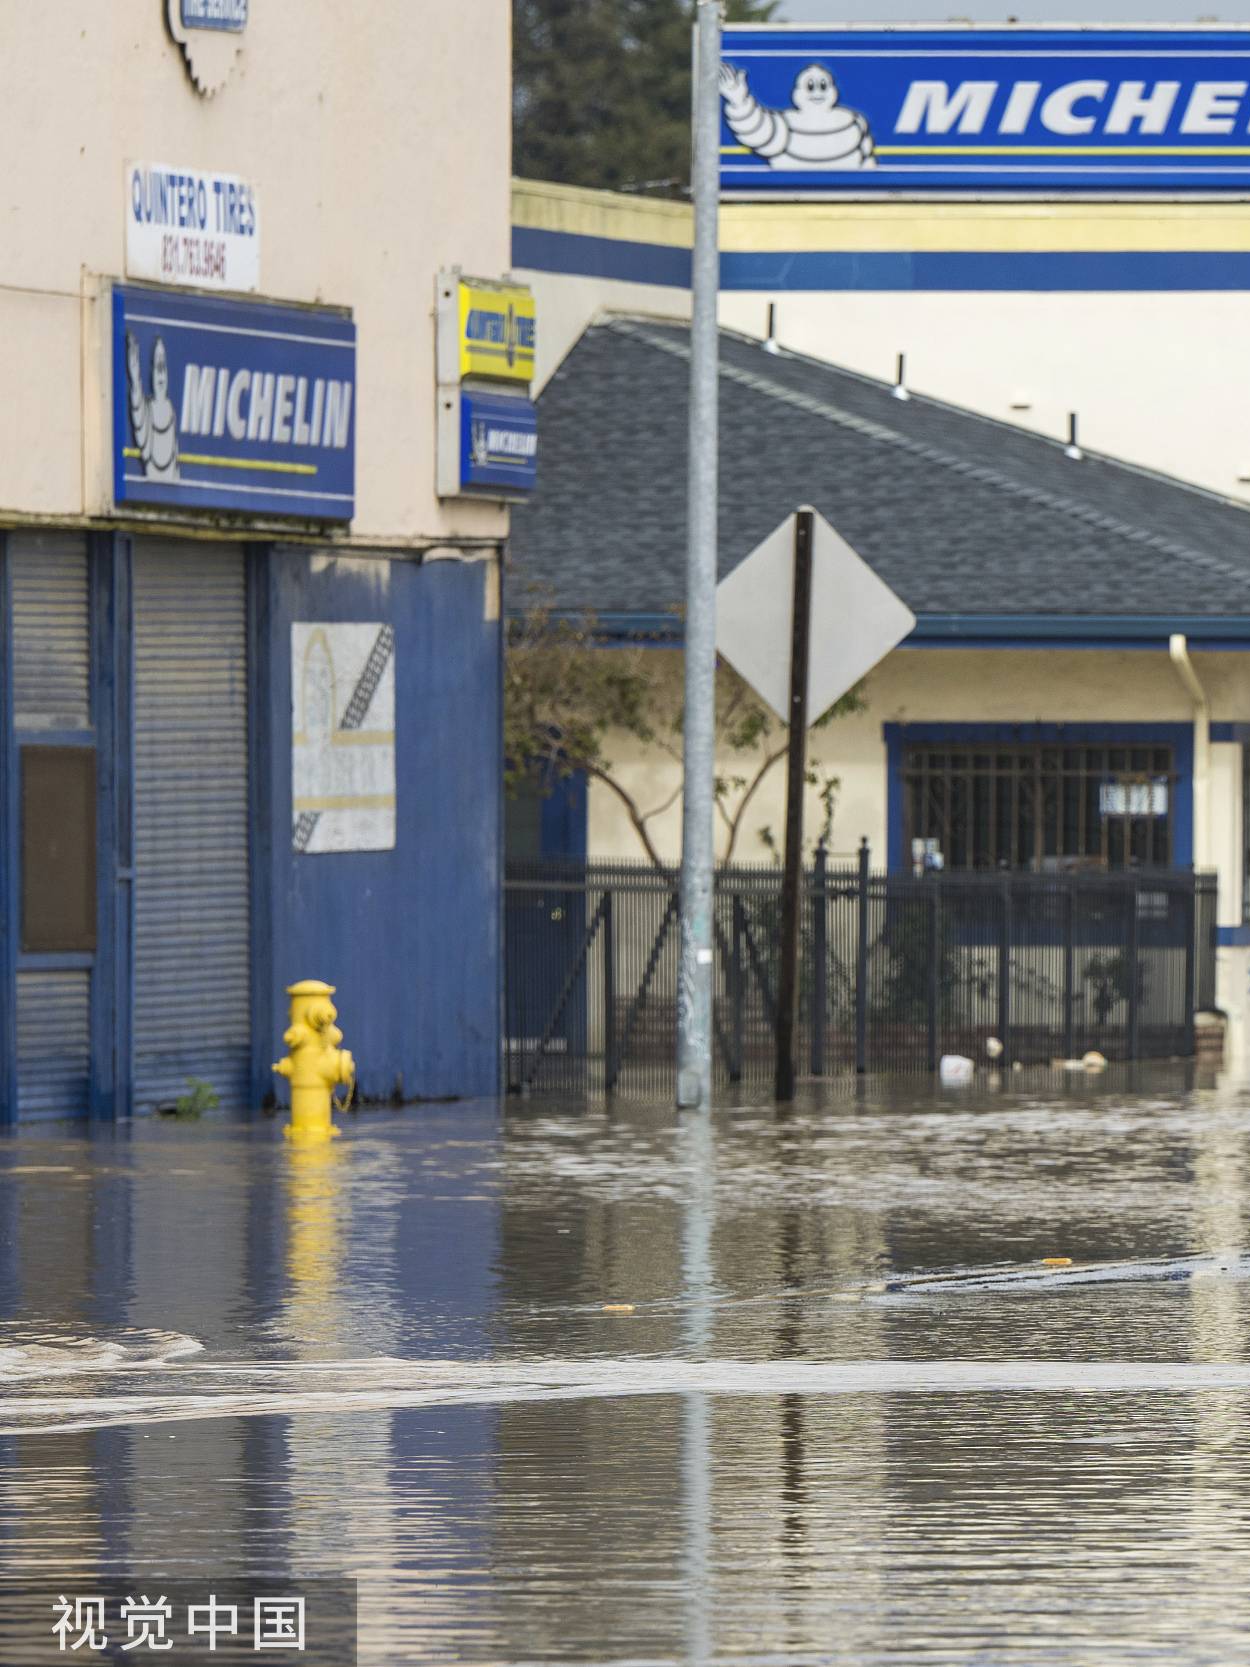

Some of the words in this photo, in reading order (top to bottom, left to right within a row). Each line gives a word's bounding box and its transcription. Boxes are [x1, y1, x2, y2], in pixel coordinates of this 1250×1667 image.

[131, 168, 207, 230] QUINTERO
[212, 180, 255, 237] TIRES
[180, 362, 353, 449] MICHELIN
